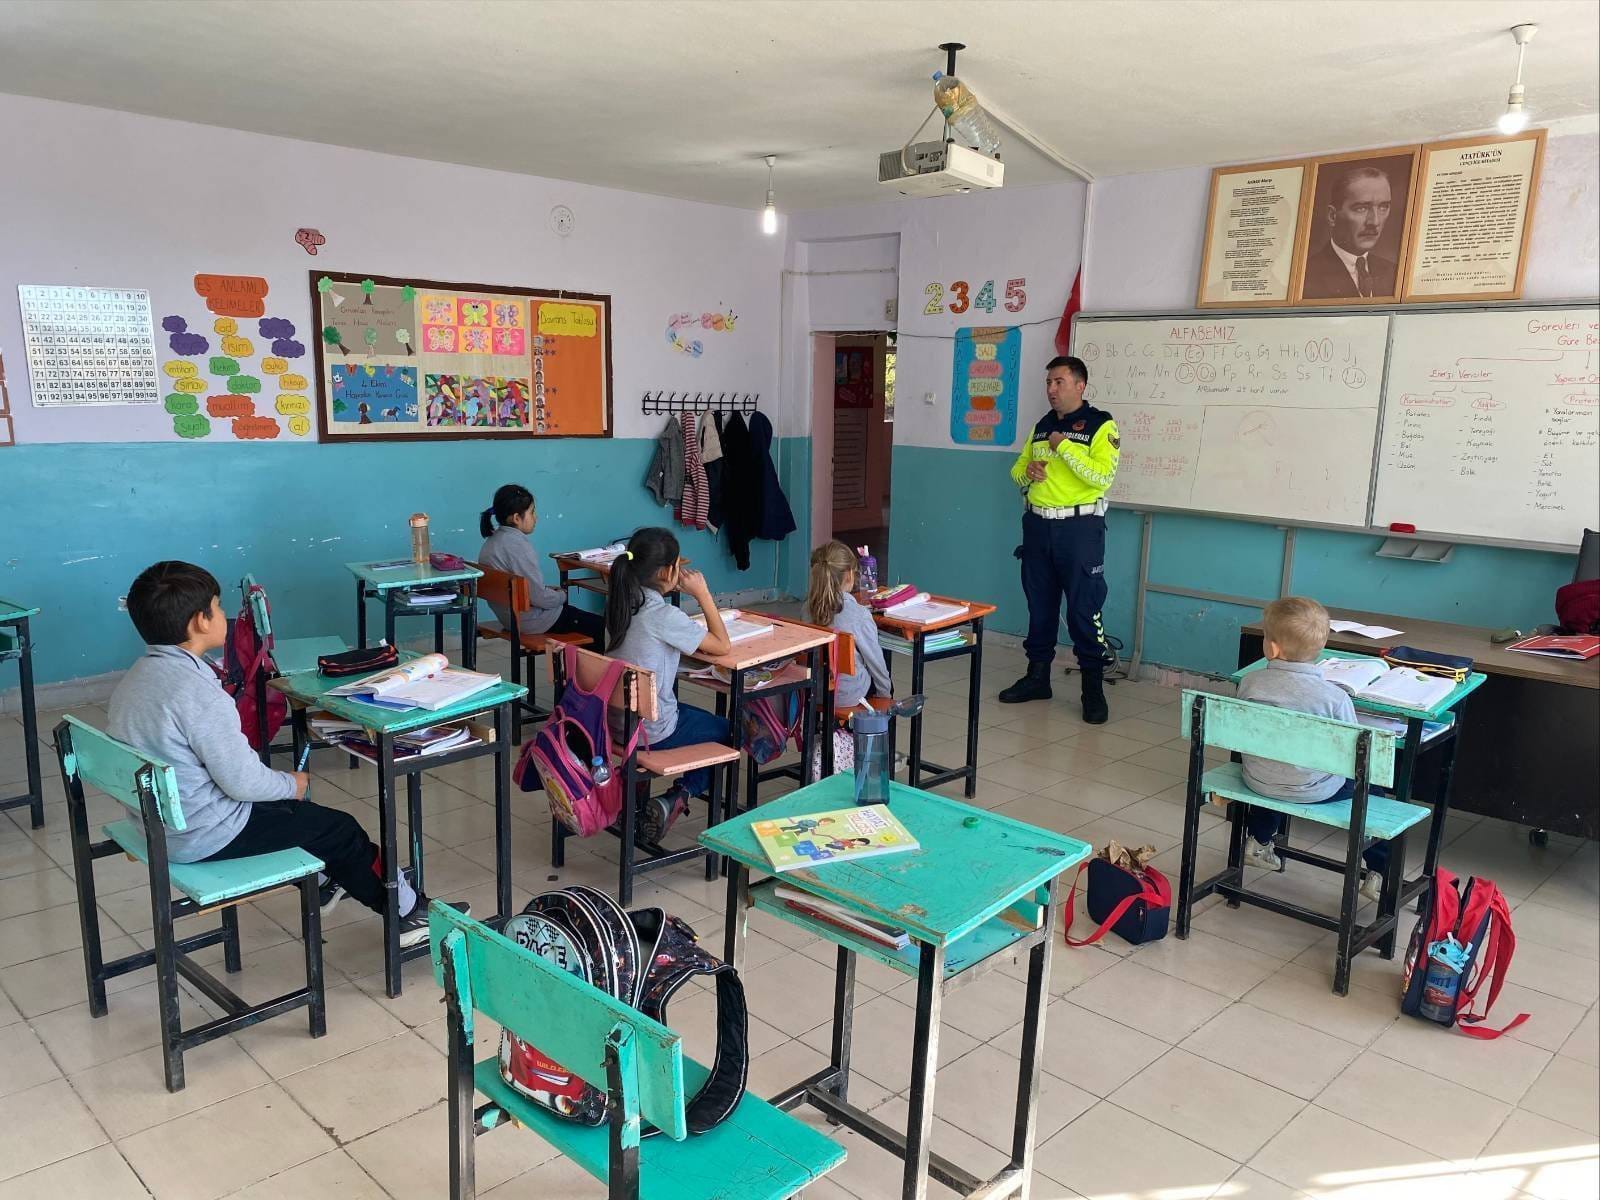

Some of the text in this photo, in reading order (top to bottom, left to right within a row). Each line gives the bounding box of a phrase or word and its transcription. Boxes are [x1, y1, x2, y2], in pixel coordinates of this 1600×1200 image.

[923, 277, 1027, 315] 2 3 4 5
[1280, 343, 1299, 358] Hh
